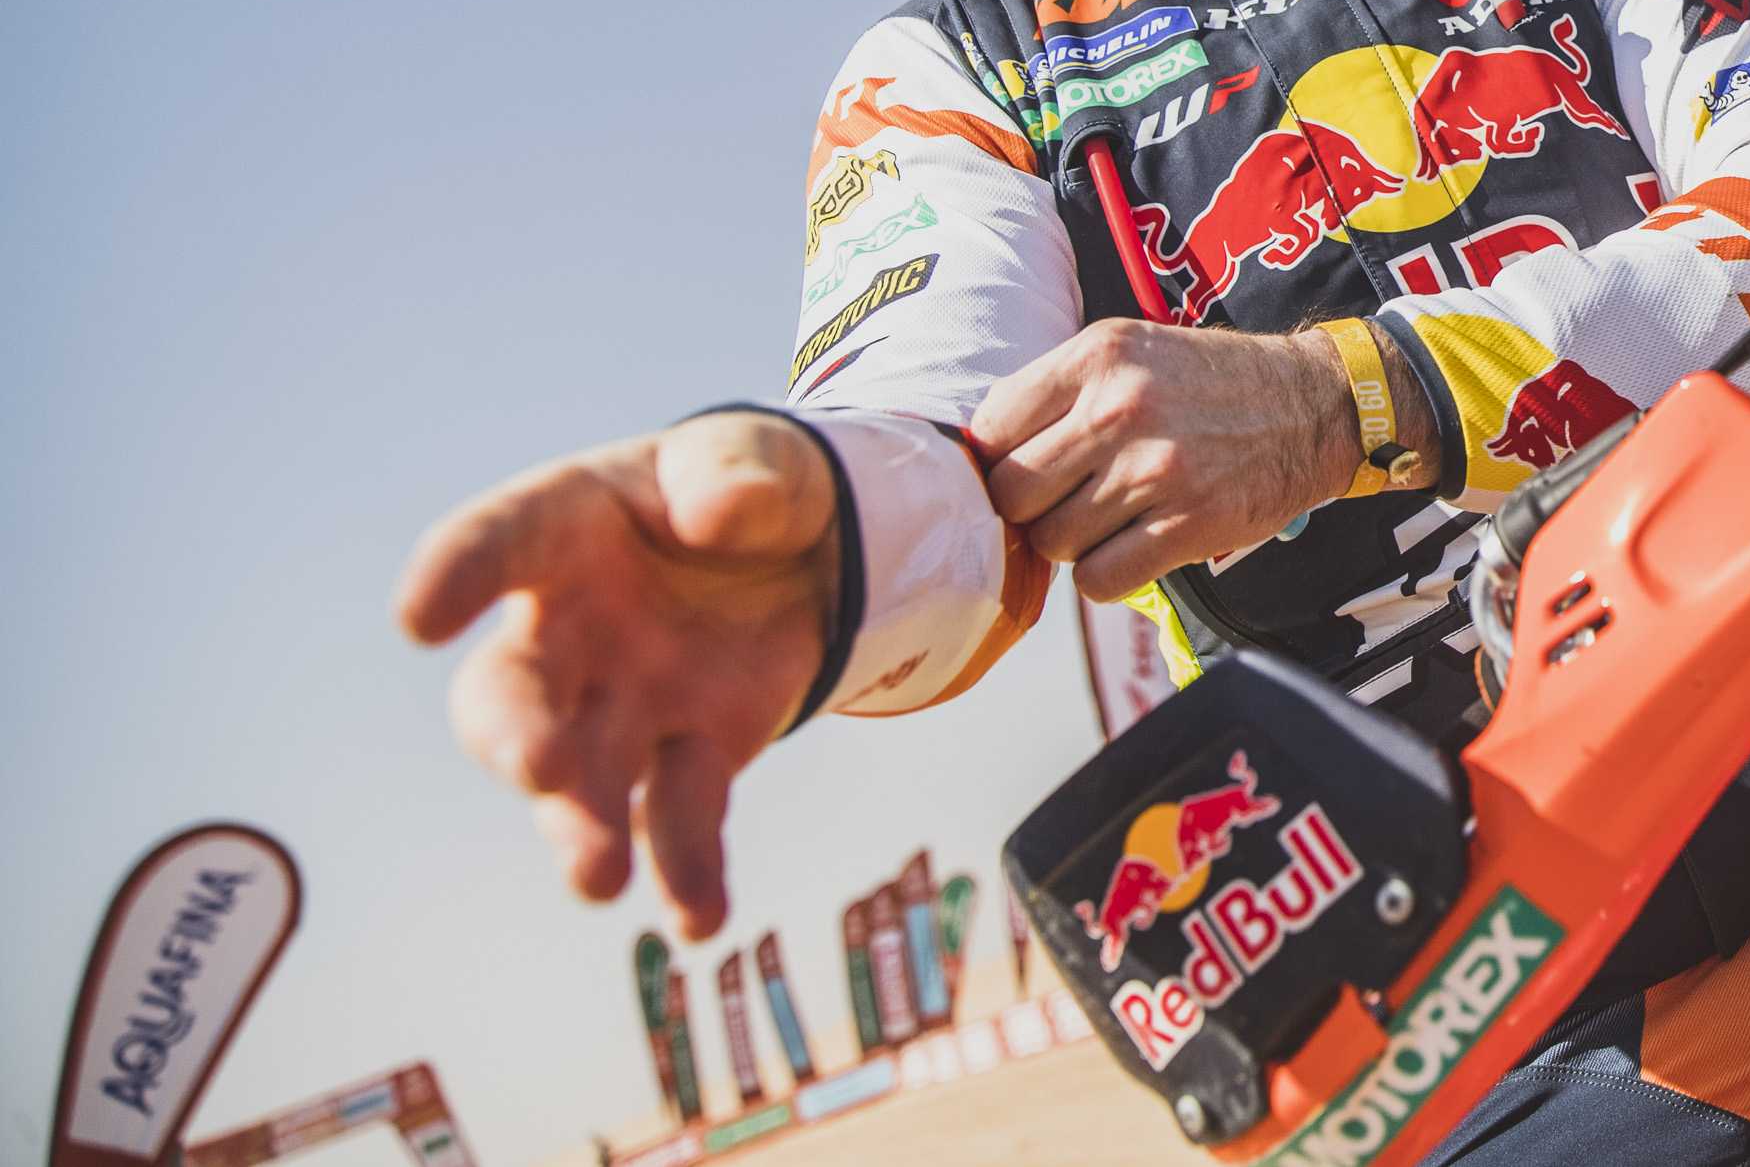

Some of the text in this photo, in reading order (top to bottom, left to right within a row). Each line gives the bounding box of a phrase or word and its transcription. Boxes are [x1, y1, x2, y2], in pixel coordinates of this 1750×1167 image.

[101, 868, 253, 1118] AQUAFINA
[1111, 910, 1243, 1071] Red
[1209, 801, 1365, 975] Bull
